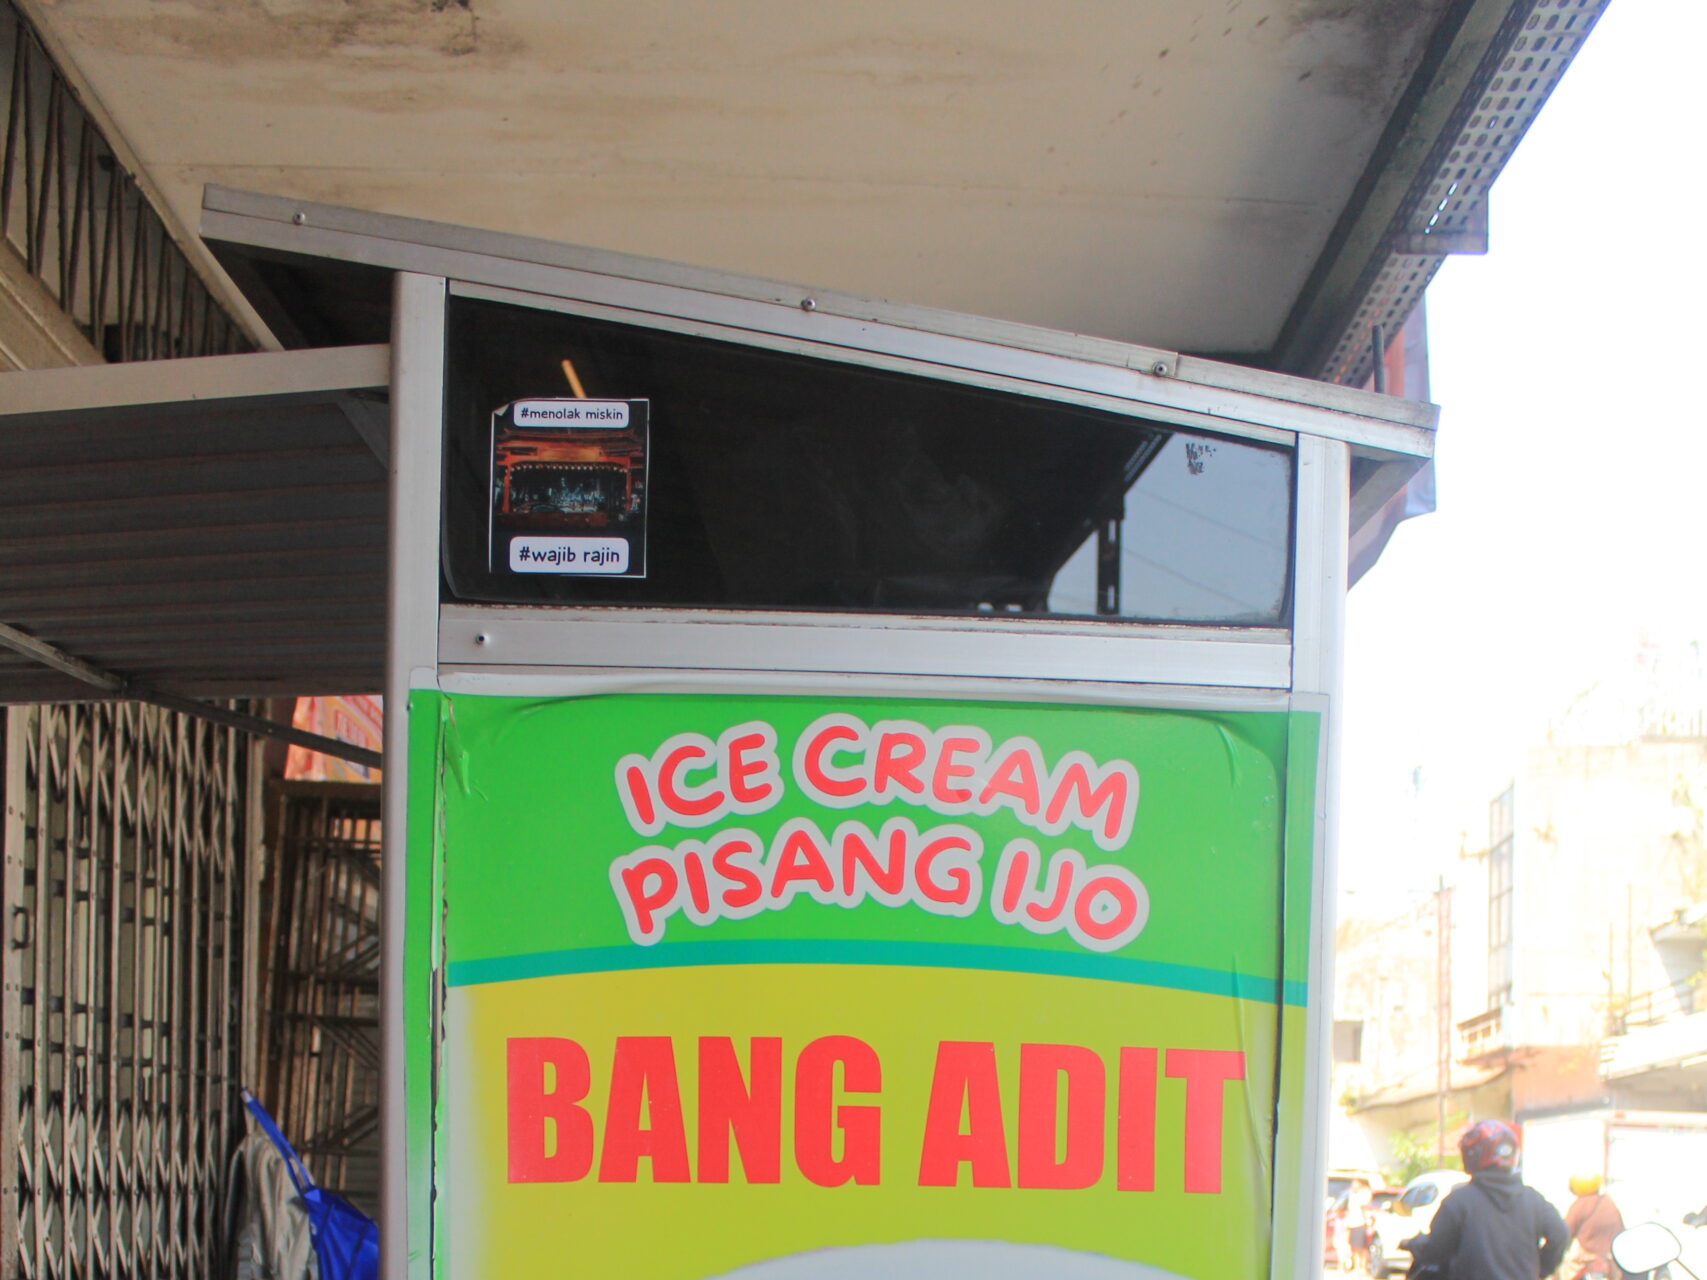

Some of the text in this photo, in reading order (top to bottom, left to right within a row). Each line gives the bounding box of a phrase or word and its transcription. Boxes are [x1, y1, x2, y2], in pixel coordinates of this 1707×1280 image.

[520, 407, 624, 420] #menolak miskin
[519, 546, 620, 566] #wajib rajin
[625, 722, 1130, 841] ICE CREAM
[619, 826, 1139, 942] PISANG IJO
[506, 1034, 1246, 1194] BANG ADIT
